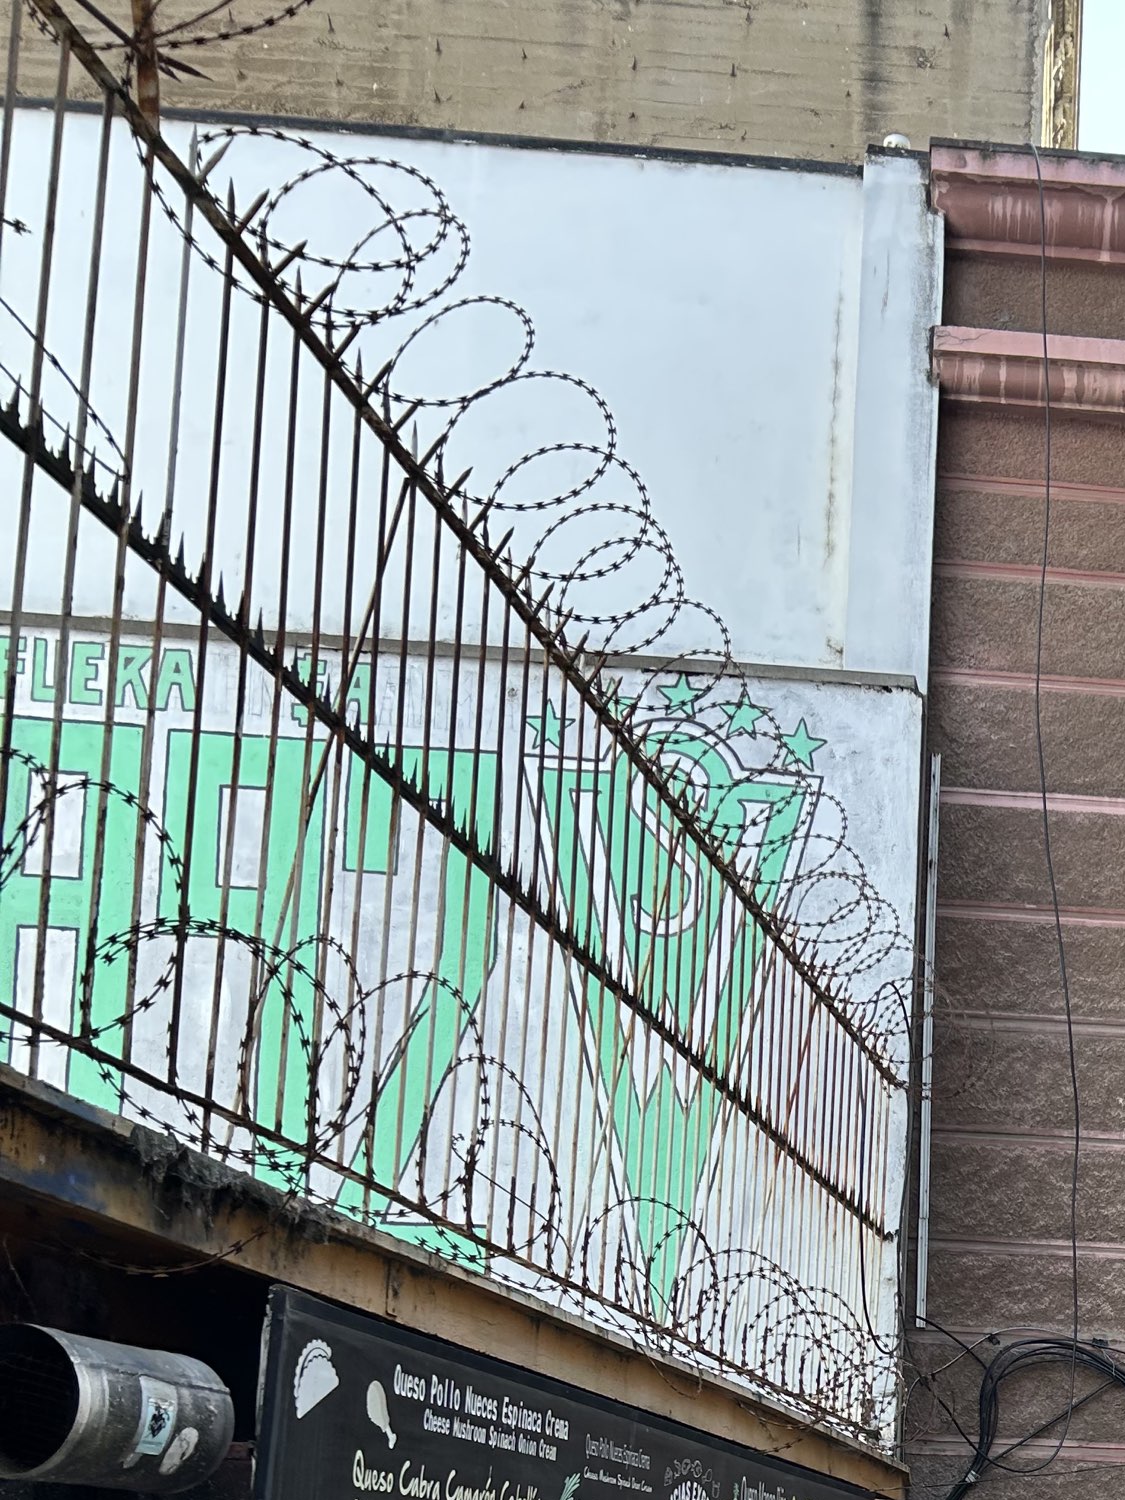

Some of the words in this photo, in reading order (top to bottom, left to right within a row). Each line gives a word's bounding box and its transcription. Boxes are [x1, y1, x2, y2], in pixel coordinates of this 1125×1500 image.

[393, 1364, 425, 1401] Queso
[431, 1375, 460, 1410] Pollo
[464, 1385, 498, 1421] Nueces
[502, 1396, 542, 1435] Espinaca
[545, 1410, 569, 1440] Crema
[423, 1408, 450, 1435] Cheese
[452, 1417, 486, 1444] Mushroom
[489, 1426, 515, 1451] Spinach
[518, 1433, 537, 1457] Onion
[539, 1438, 557, 1461] Cream
[352, 1449, 394, 1493] Queso
[399, 1460, 440, 1500] Cabra
